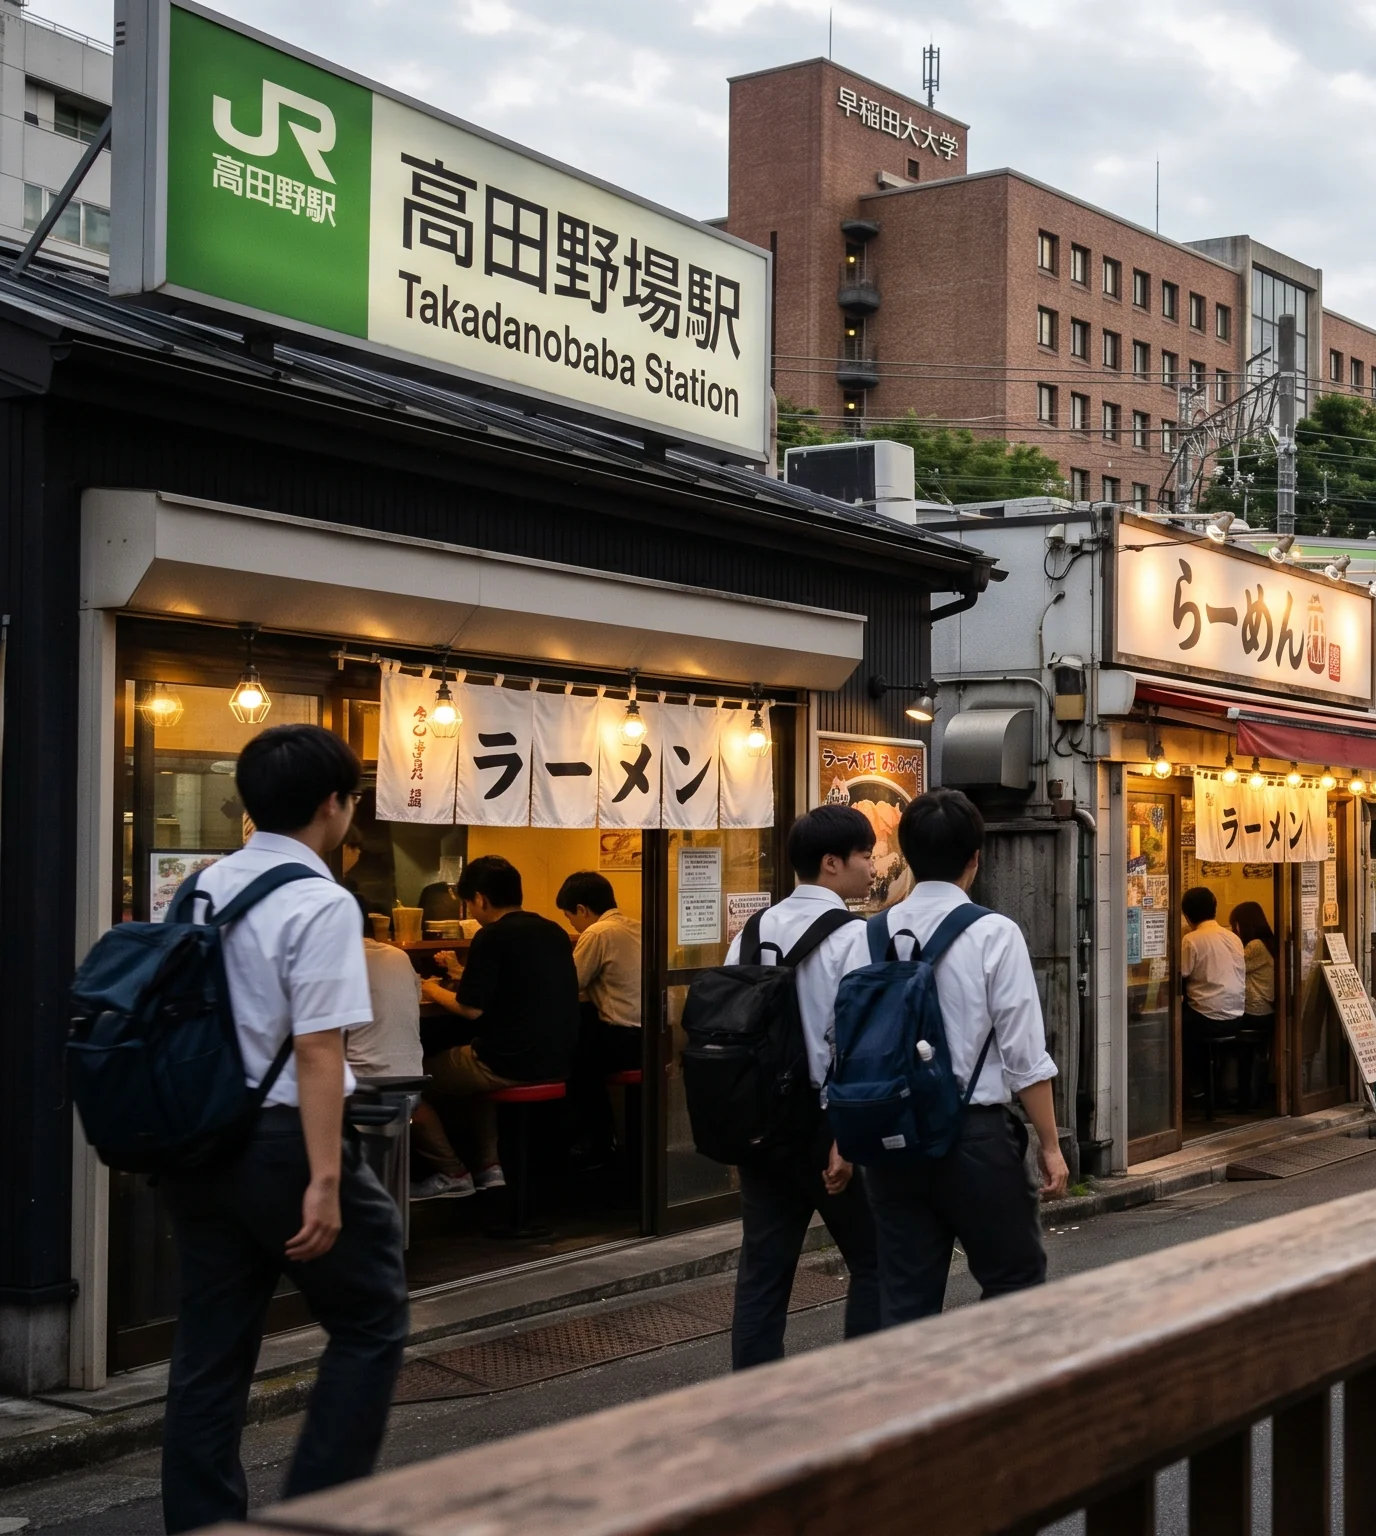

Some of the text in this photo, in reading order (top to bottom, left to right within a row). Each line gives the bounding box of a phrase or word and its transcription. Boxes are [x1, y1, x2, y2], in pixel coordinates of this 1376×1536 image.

[213, 79, 337, 184] JR
[836, 86, 960, 161] 早稲田大大学
[212, 152, 337, 228] 高田野駅
[400, 152, 741, 360] 高田野場駅
[399, 269, 740, 417] Takadanobaba Station
[1173, 558, 1305, 671] らーめん
[473, 731, 712, 805] ラーメン
[1221, 807, 1304, 850] ラーメン
